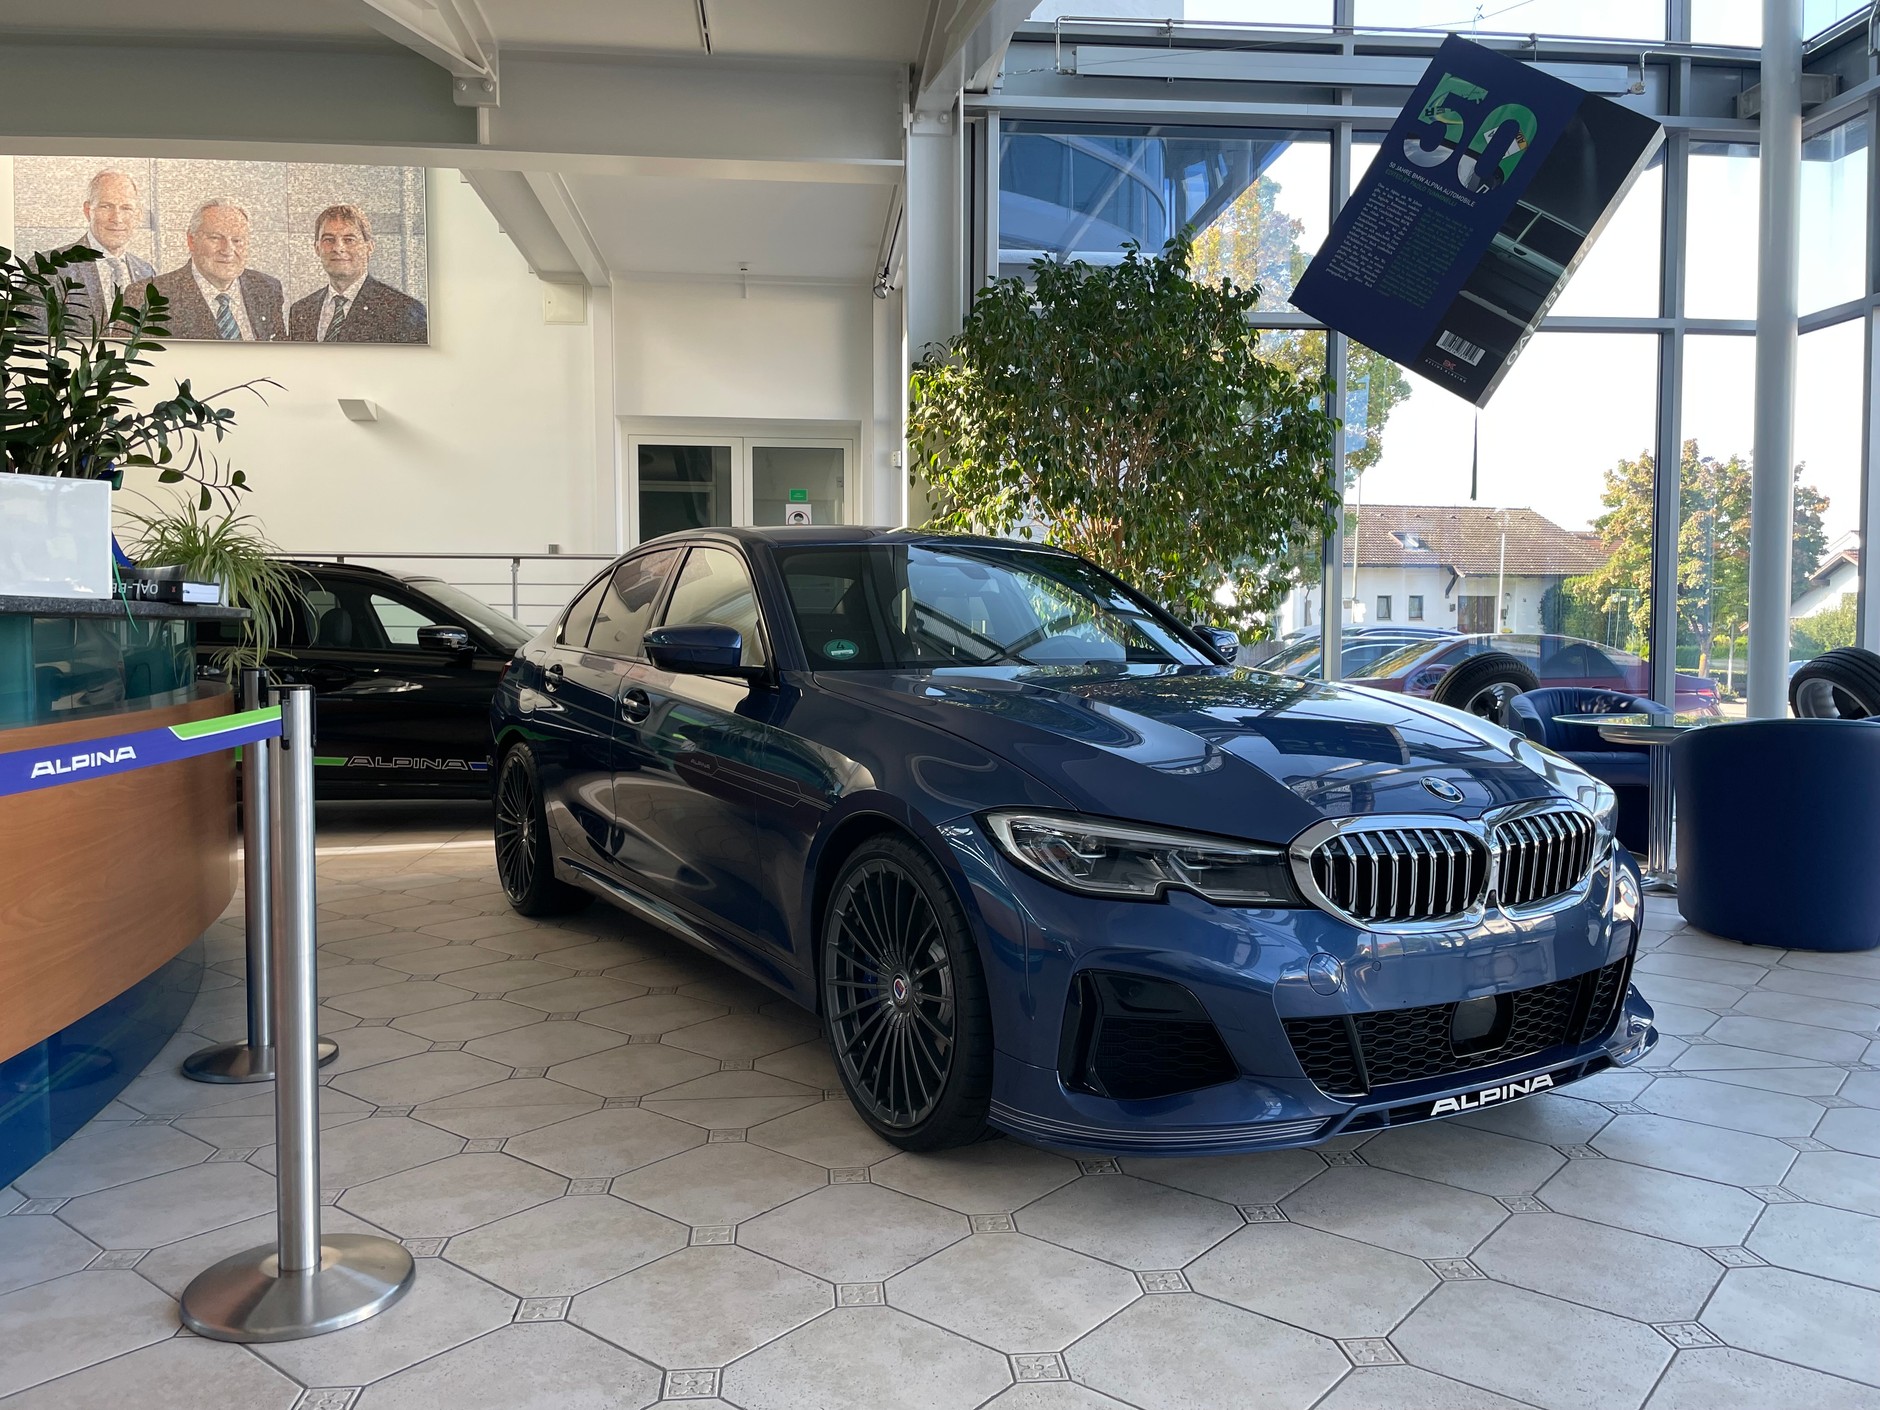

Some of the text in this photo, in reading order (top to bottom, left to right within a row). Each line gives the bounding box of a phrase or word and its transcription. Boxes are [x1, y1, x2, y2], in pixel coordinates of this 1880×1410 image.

[1403, 72, 1538, 194] 50
[1388, 161, 1476, 208] 50 JAHRE BMW ALPINA AUTOMOBILE
[1506, 272, 1569, 367] OAL-BE
[836, 641, 845, 650] 4
[30, 745, 137, 779] ALPINA
[347, 755, 469, 771] ALPINA
[1430, 1073, 1554, 1117] ALPINA
